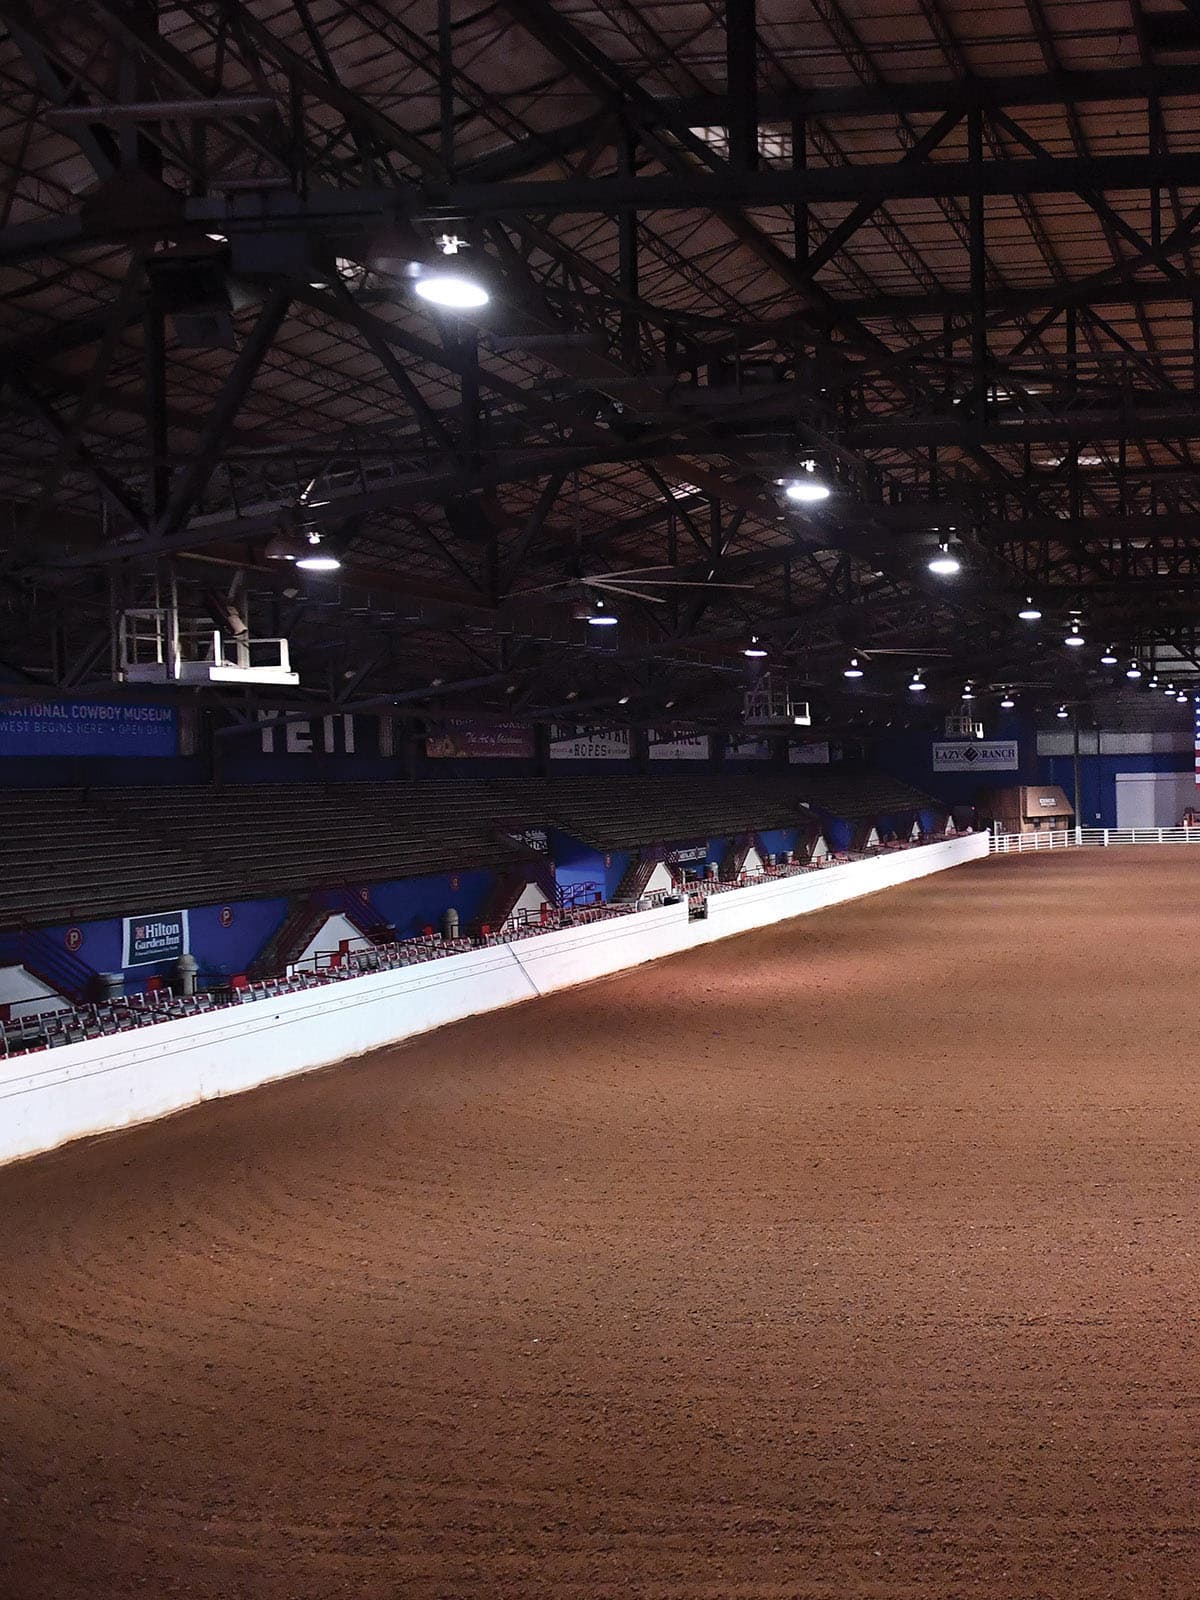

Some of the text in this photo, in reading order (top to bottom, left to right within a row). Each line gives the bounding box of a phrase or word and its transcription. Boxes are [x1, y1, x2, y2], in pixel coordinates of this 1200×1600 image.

[72, 705, 122, 720] COWBOY
[124, 706, 172, 721] MUSEUM
[34, 721, 73, 734] BEGINS
[77, 722, 104, 734] HERE
[575, 744, 607, 757] ROPES
[936, 751, 959, 760] LAZY
[983, 749, 1015, 758] RANCH
[146, 923, 180, 939] Hilton
[135, 936, 180, 950] Garden Inn
